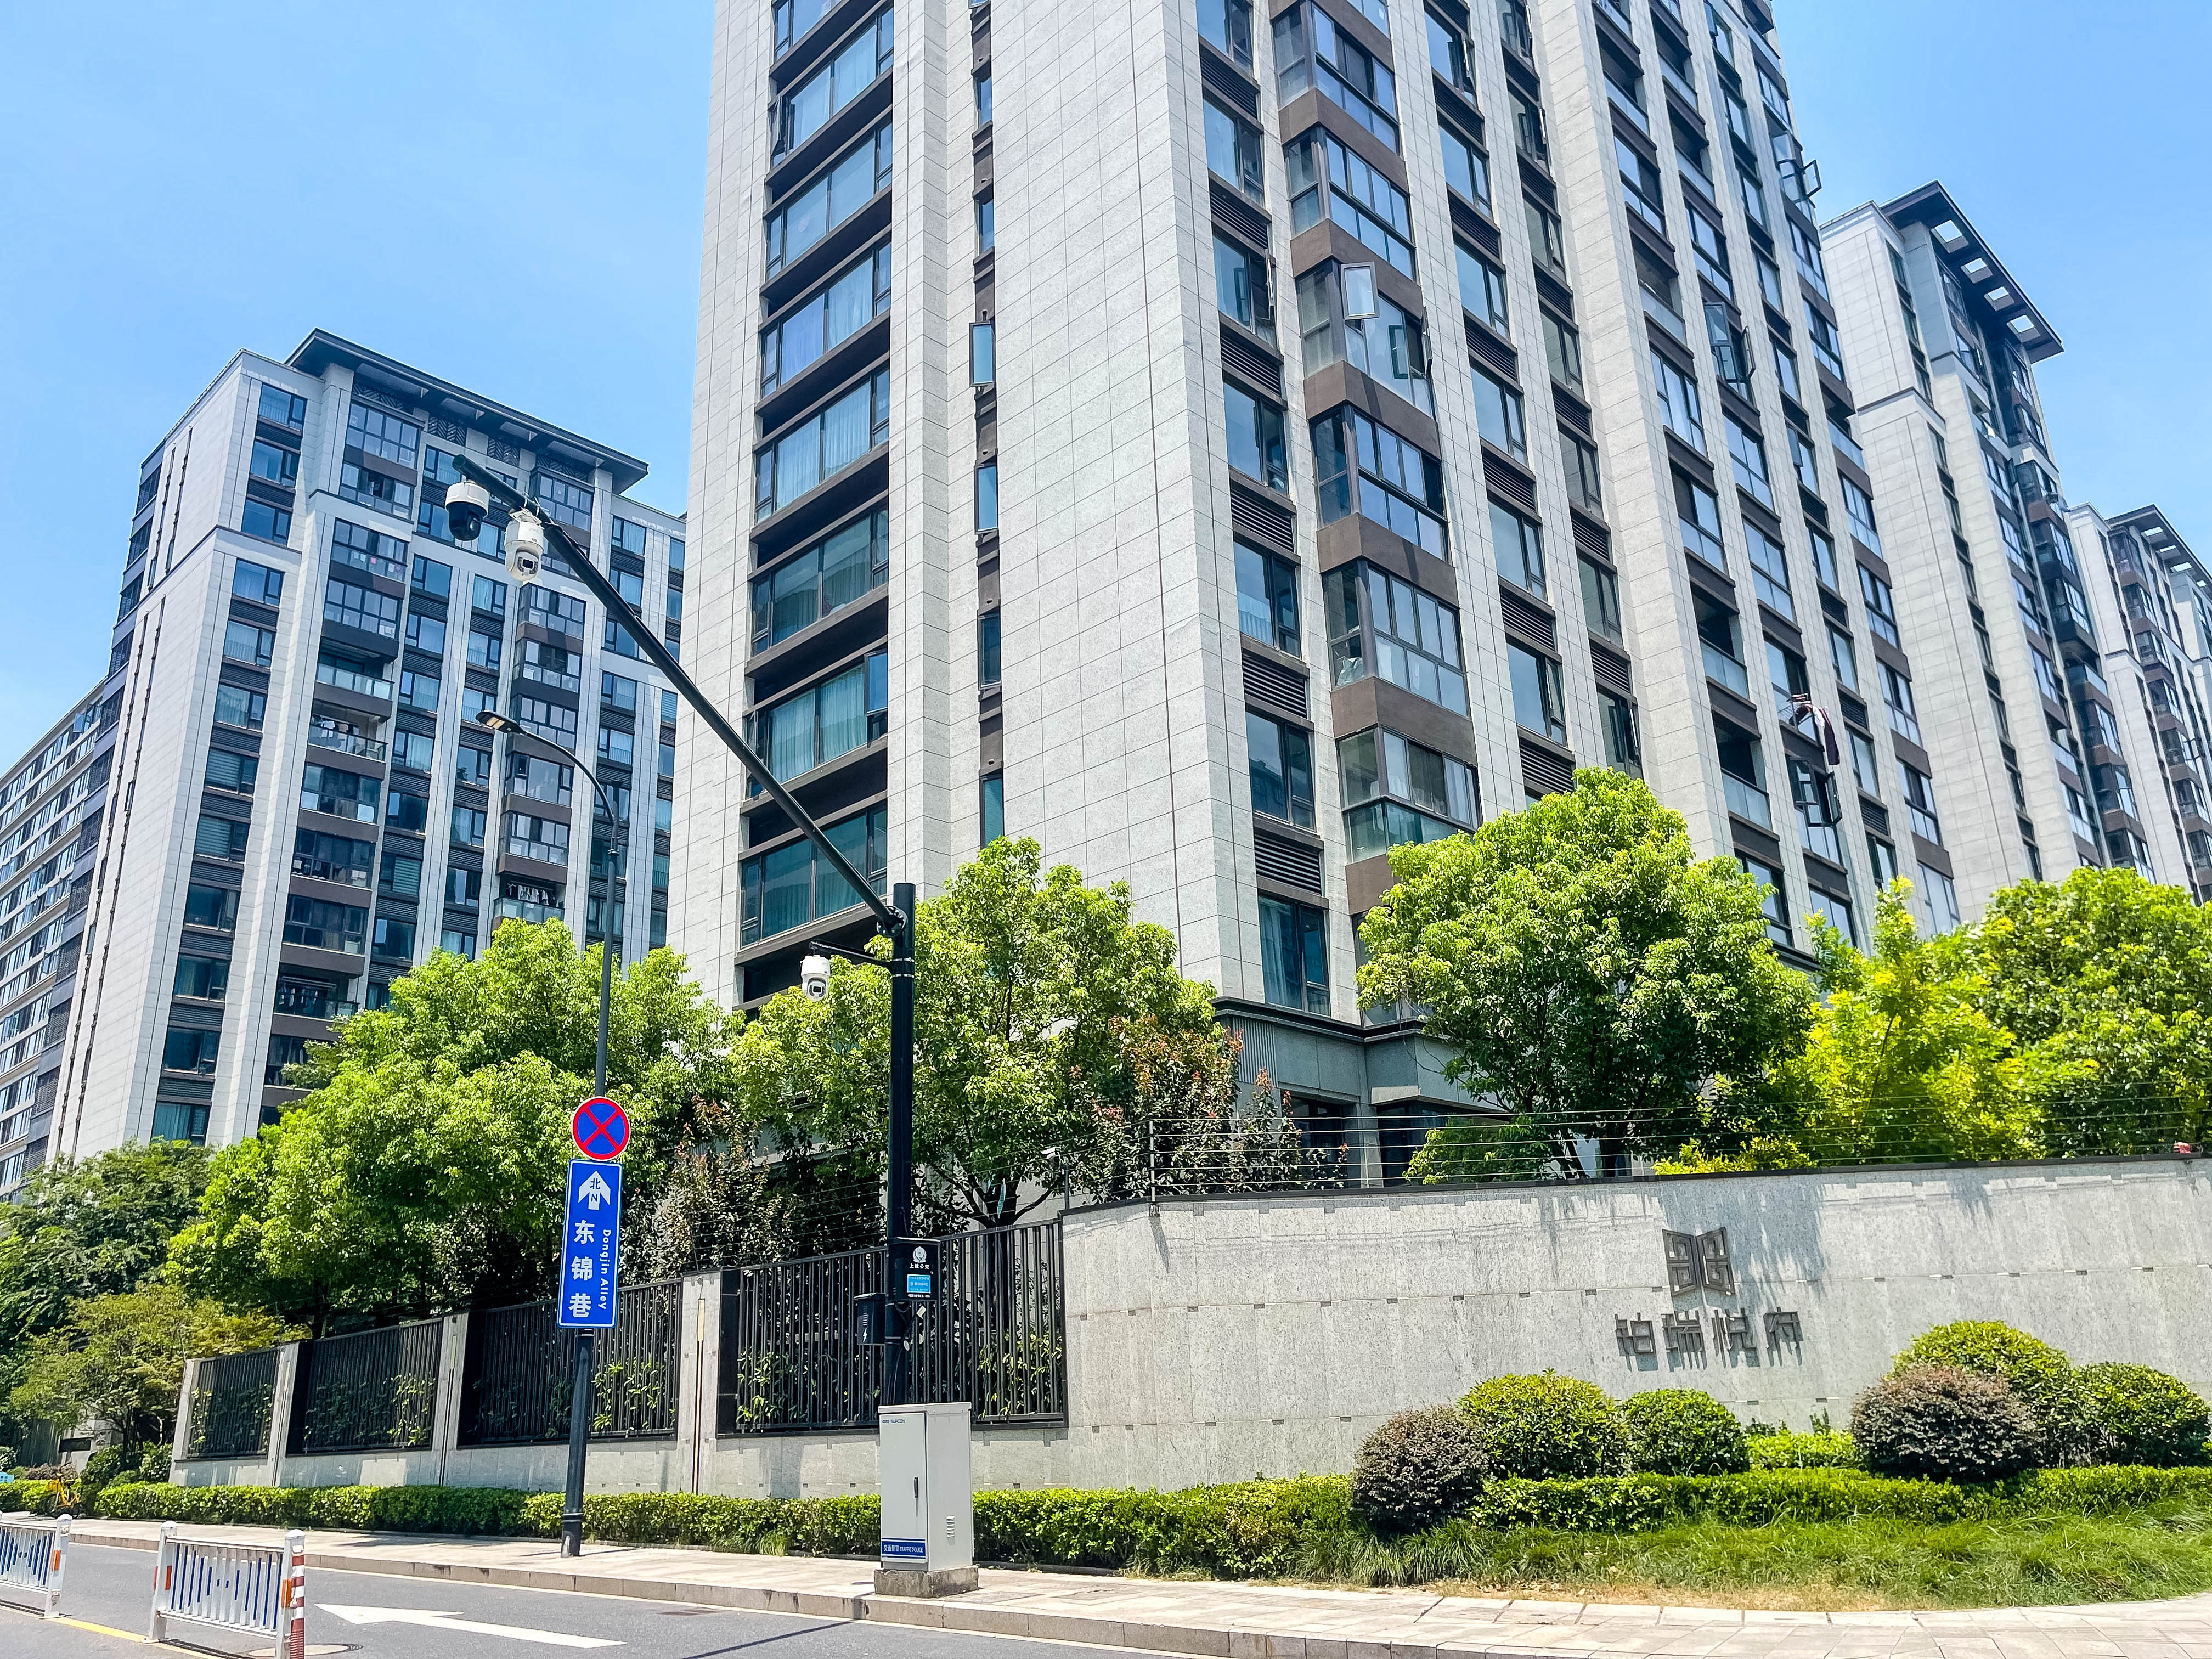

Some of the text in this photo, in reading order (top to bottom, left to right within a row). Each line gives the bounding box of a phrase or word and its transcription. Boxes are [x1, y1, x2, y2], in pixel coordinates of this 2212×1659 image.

[590, 1177, 601, 1189] 北
[591, 1193, 597, 1202] N
[568, 1220, 595, 1318] 东锦巷
[597, 1229, 611, 1310] Dongjin Alley
